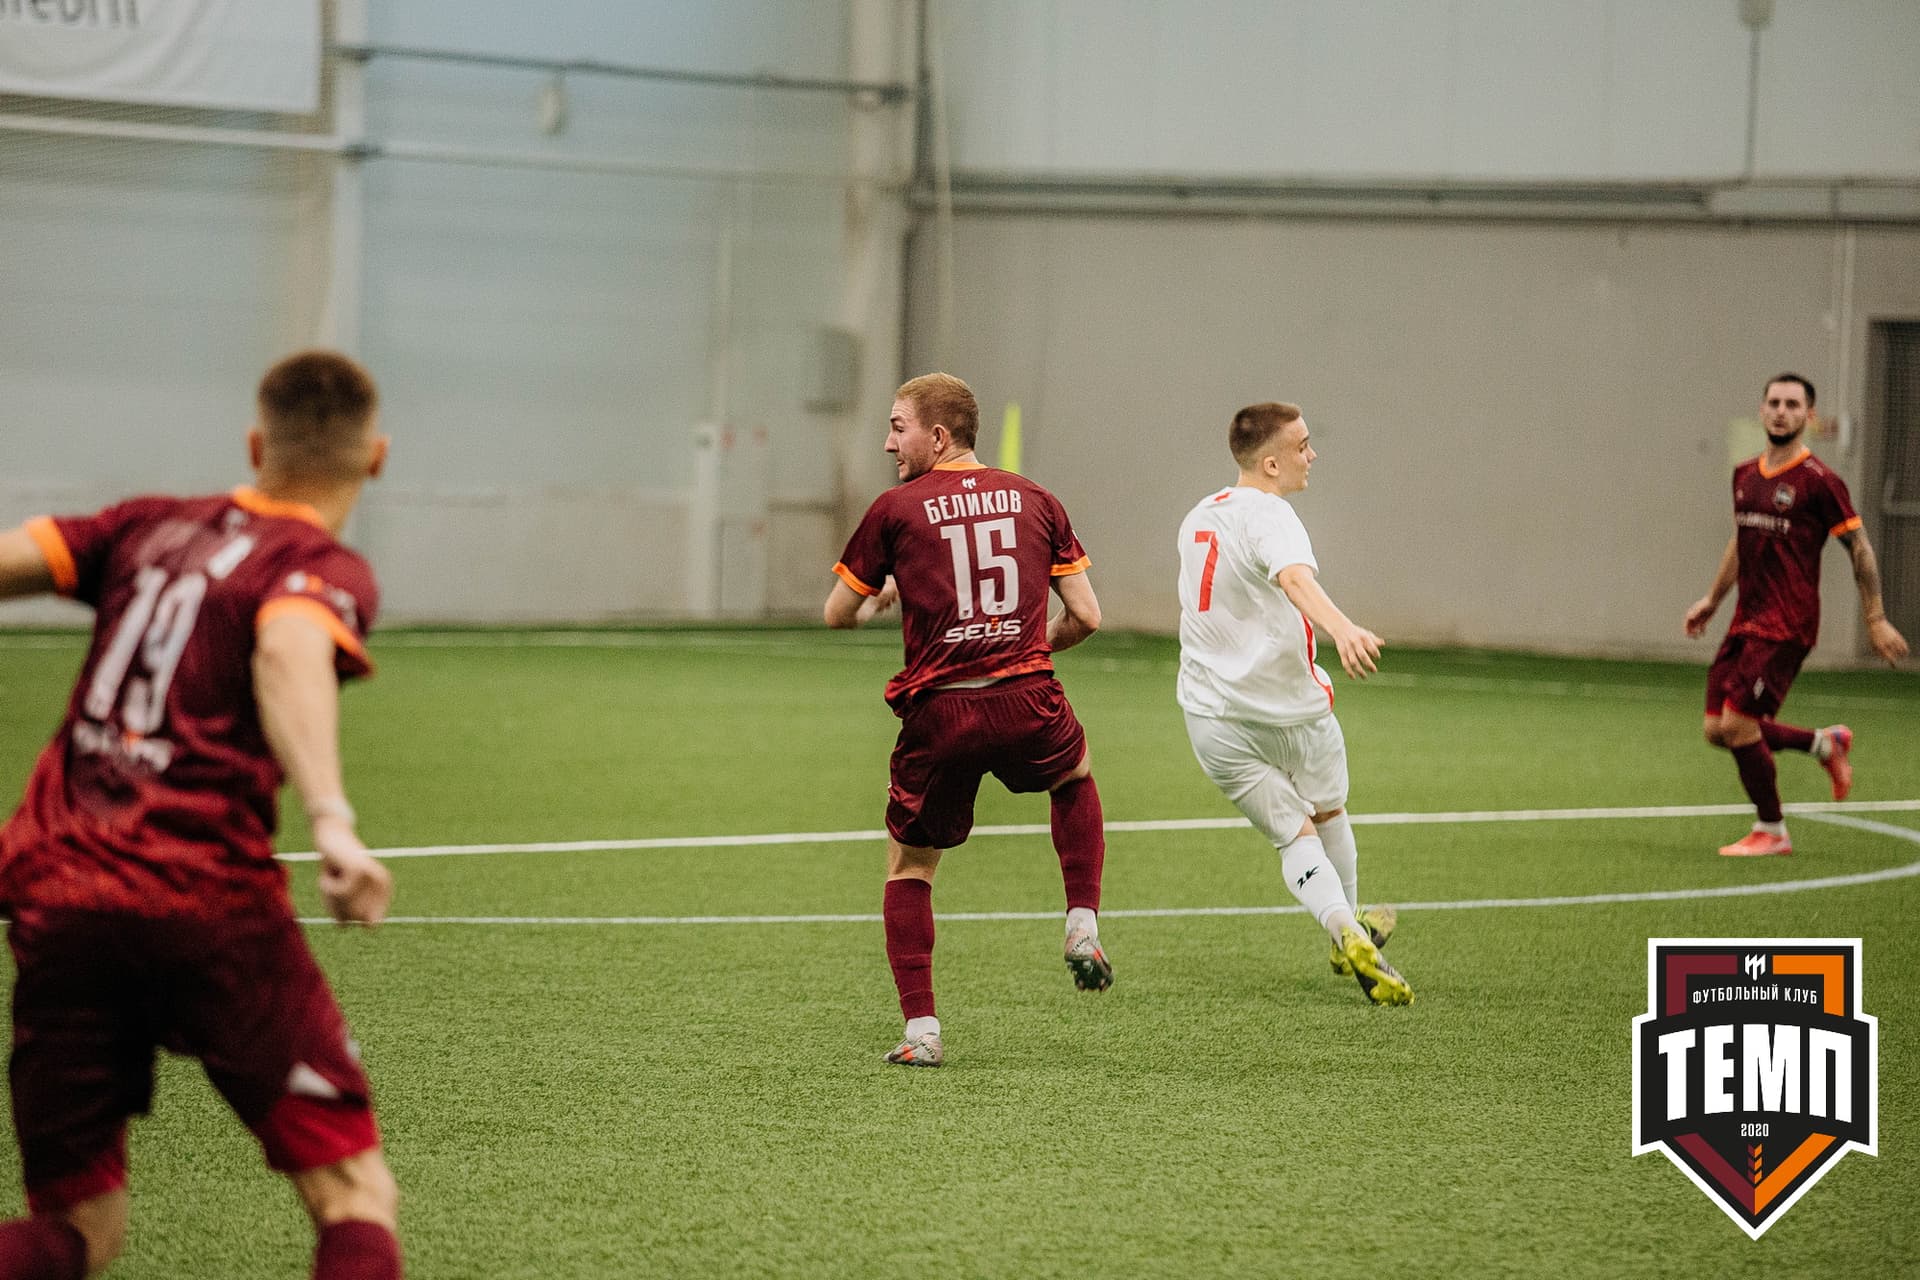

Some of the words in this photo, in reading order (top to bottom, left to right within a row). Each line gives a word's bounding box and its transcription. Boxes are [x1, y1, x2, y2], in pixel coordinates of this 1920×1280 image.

[923, 489, 1022, 525] БЕЛИКОВ
[940, 517, 1019, 621] 15
[1194, 530, 1219, 612] 7
[84, 567, 207, 734] 19
